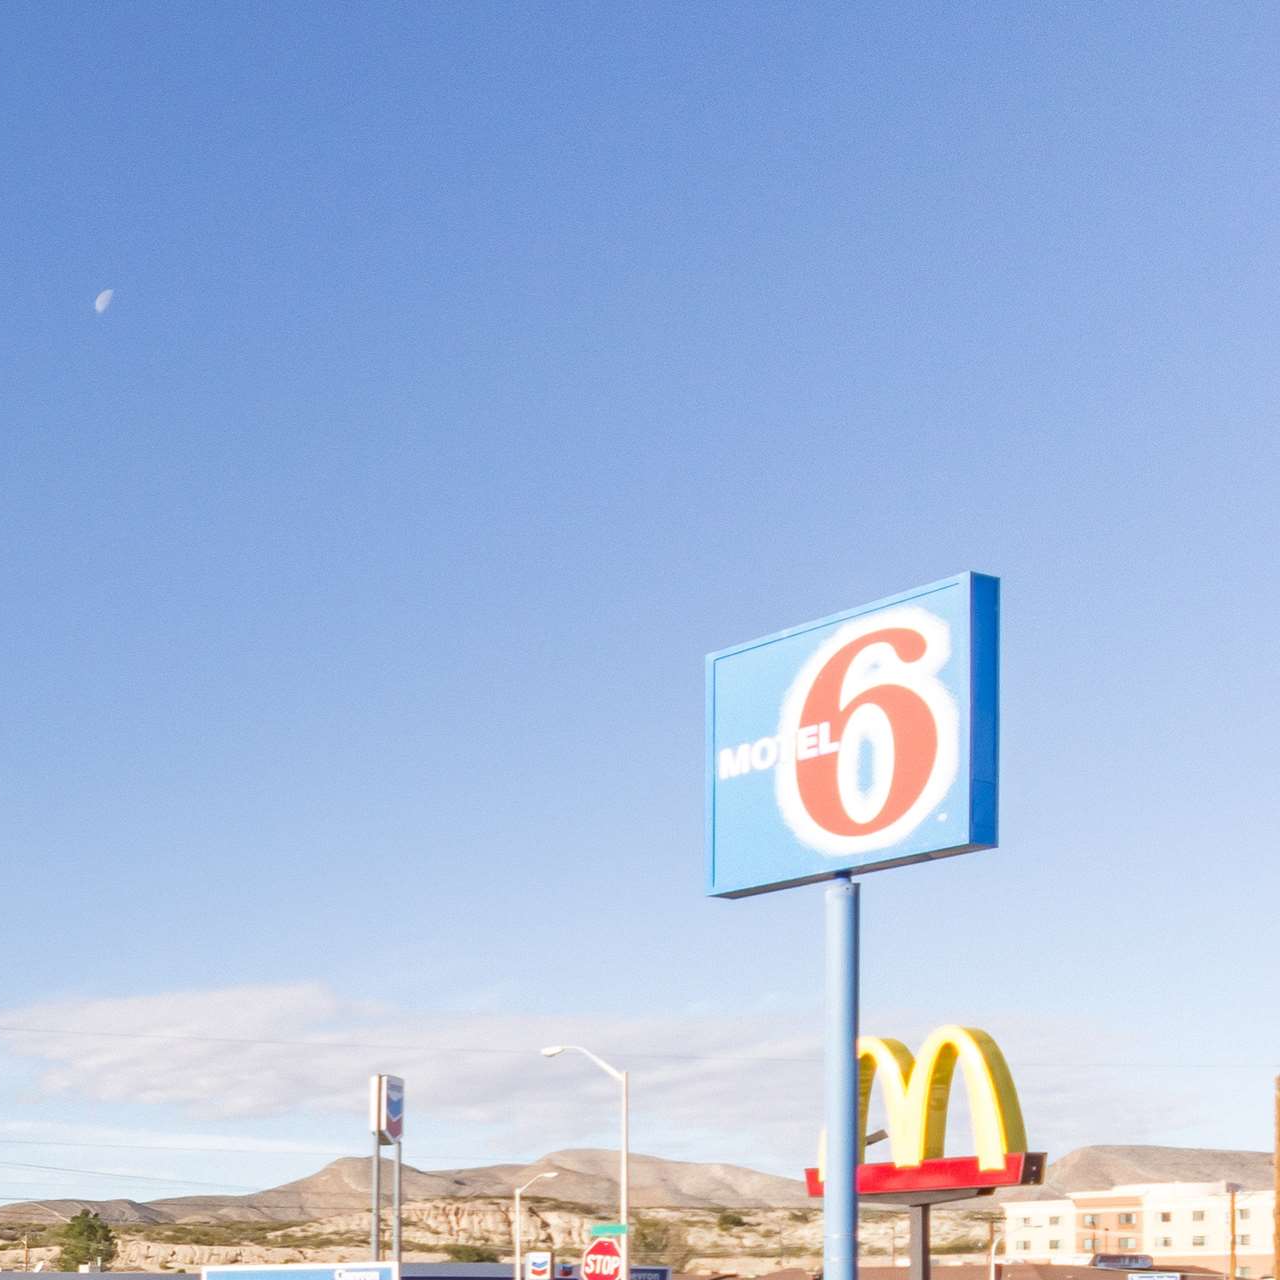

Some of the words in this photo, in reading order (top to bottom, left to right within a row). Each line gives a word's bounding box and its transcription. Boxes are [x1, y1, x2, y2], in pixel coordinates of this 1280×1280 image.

[794, 626, 939, 837] 6
[585, 1254, 621, 1275] STOP
[631, 1271, 661, 1280] evron
